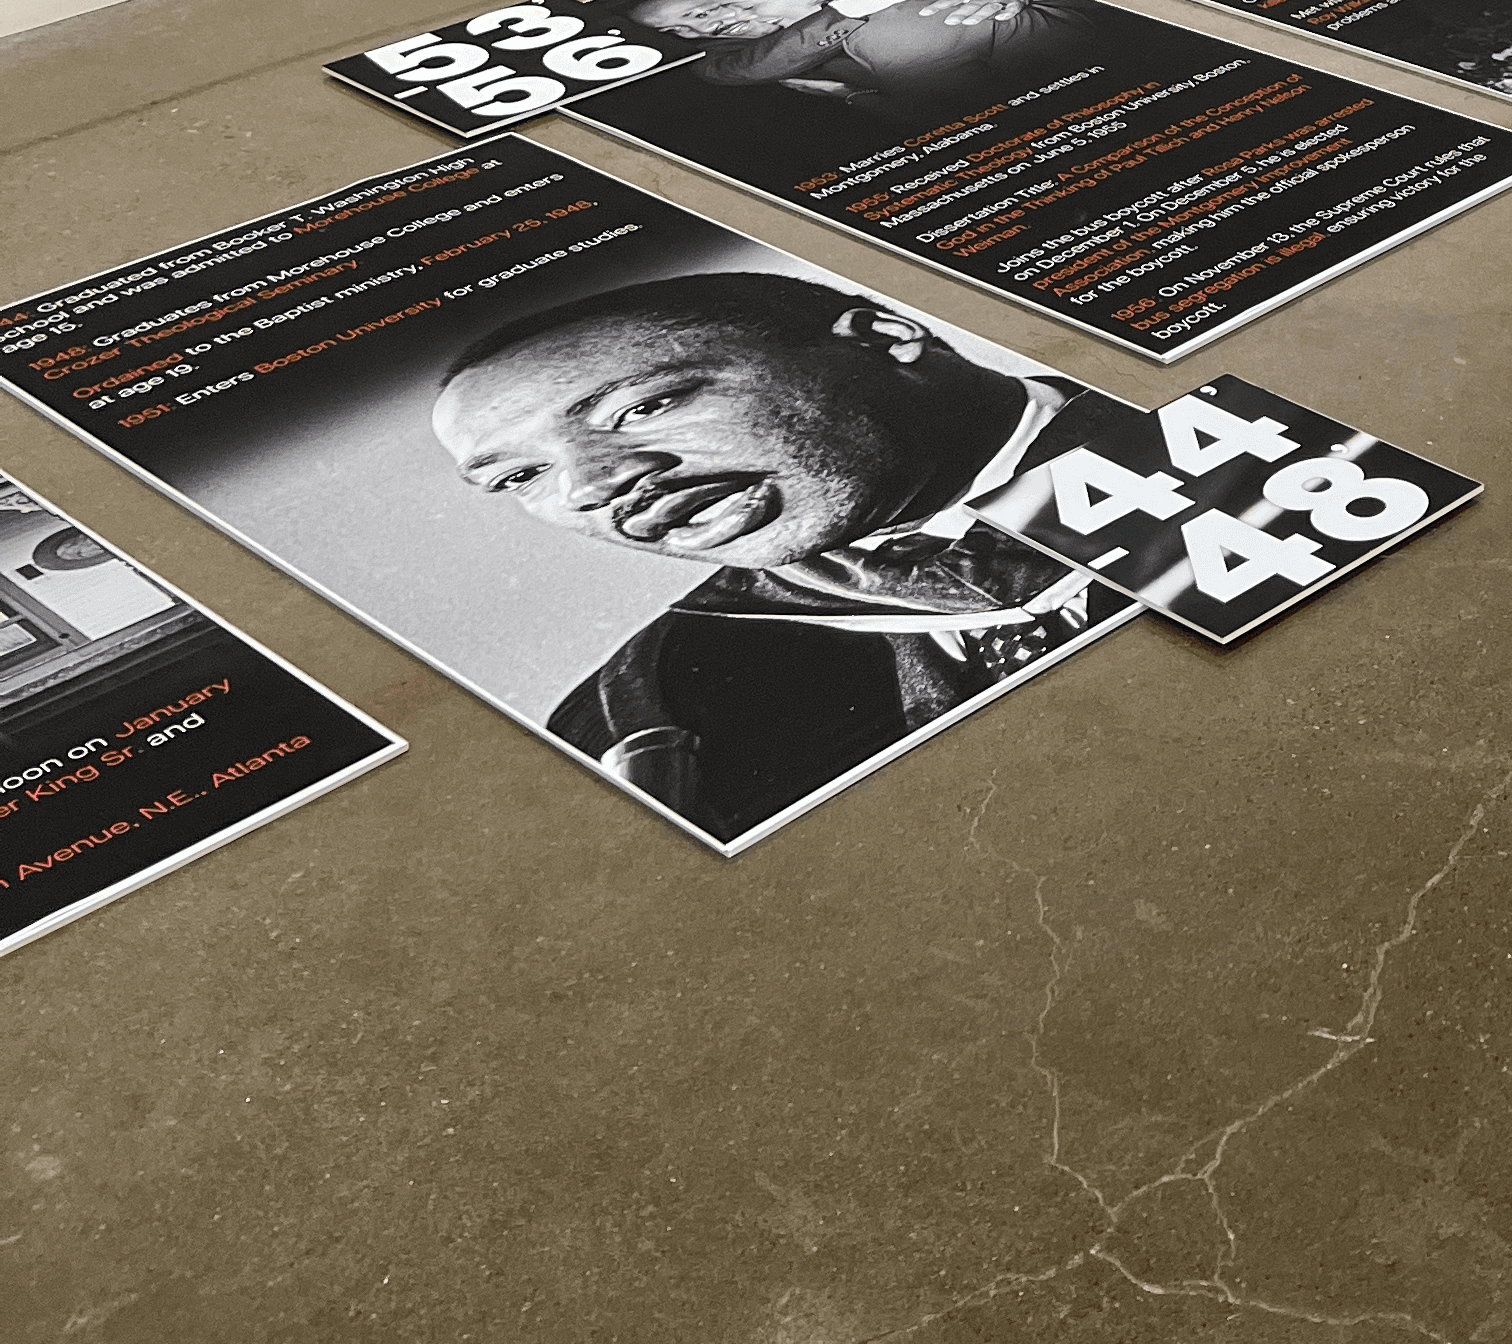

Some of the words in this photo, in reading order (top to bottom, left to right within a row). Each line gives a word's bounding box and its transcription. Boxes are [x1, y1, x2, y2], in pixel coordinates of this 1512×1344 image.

[27, 343, 92, 371] 1948:
[91, 299, 213, 347] Graduates
[211, 279, 268, 303] from
[264, 235, 386, 283] Morehouse
[385, 208, 462, 238] College
[462, 193, 503, 212] and
[502, 172, 564, 197] enters
[35, 265, 159, 313] Graduated
[156, 247, 213, 270] from
[210, 219, 287, 251] Booker
[287, 212, 313, 223] T.
[309, 171, 430, 215] Washington
[426, 156, 475, 175] High
[71, 292, 120, 315] and
[118, 275, 169, 296] was
[170, 239, 268, 279] admitted
[267, 231, 293, 243] to
[292, 190, 407, 235] Morehouse
[406, 166, 480, 192] College
[480, 158, 503, 170] at
[996, 247, 1045, 273] Joins
[1040, 233, 1075, 250] the
[1068, 218, 1108, 237] bus
[1101, 190, 1170, 222] boycott
[1165, 172, 1204, 194] after
[1012, 266, 1041, 281] on
[1034, 224, 1125, 270] December
[1121, 219, 1141, 228] 1.
[1135, 208, 1167, 222] On
[1159, 170, 1243, 211] December
[1239, 164, 1263, 174] 5,
[1254, 154, 1282, 167] he
[1274, 147, 1297, 158] is
[1293, 122, 1350, 151] elected
[1051, 248, 1156, 298] Association,
[1150, 217, 1217, 250] making
[1206, 203, 1245, 222] him
[1239, 190, 1271, 206] the
[1268, 166, 1320, 194] official
[1315, 123, 1416, 172] spokesperson
[1068, 288, 1099, 306] for
[1096, 274, 1132, 292] the
[1124, 243, 1199, 277] boycott.
[1109, 295, 1162, 321] 1956:
[1157, 281, 1190, 297] On
[1182, 240, 1270, 285] November
[1265, 231, 1296, 244] 13,
[1287, 217, 1321, 234] the
[1314, 184, 1387, 220] Supreme
[1381, 164, 1429, 187] Court
[1423, 148, 1463, 169] rules
[1456, 134, 1492, 152] that
[1129, 310, 1171, 331] bus
[1167, 262, 1267, 313] segregation
[1262, 254, 1282, 265] is
[1276, 230, 1331, 257] illegal,
[1325, 197, 1397, 233] ensuring
[1388, 174, 1442, 201] victory
[1434, 163, 1462, 178] for
[1456, 152, 1487, 167] the
[0, 332, 48, 354] age
[47, 320, 83, 335] 15.
[42, 346, 121, 380] Crozer
[123, 295, 257, 348] Theological
[255, 258, 358, 300] Seminary
[71, 352, 184, 399] Ordained
[183, 342, 212, 356] to
[212, 326, 254, 345] the
[251, 295, 335, 329] Baptist
[333, 263, 424, 299] ministry,
[419, 228, 511, 266] February
[511, 218, 548, 232] 25,
[544, 199, 598, 219] 1948,
[116, 401, 176, 428] 1951:
[173, 370, 255, 406] Enters
[252, 339, 338, 374] Boston
[335, 296, 441, 341] University
[442, 283, 474, 300] for
[476, 249, 568, 289] graduate
[567, 222, 643, 253] studies.
[1149, 301, 1227, 340] boycott.
[87, 394, 116, 410] at
[116, 375, 165, 398] age
[164, 362, 200, 378] 19.
[23, 763, 100, 802] King
[99, 744, 144, 766] Sr.
[145, 711, 206, 747] and
[66, 736, 109, 760] on
[114, 677, 230, 738] January
[17, 820, 140, 881] Avenue,
[137, 788, 207, 820] N.E.,
[211, 734, 311, 789] Atlanta
